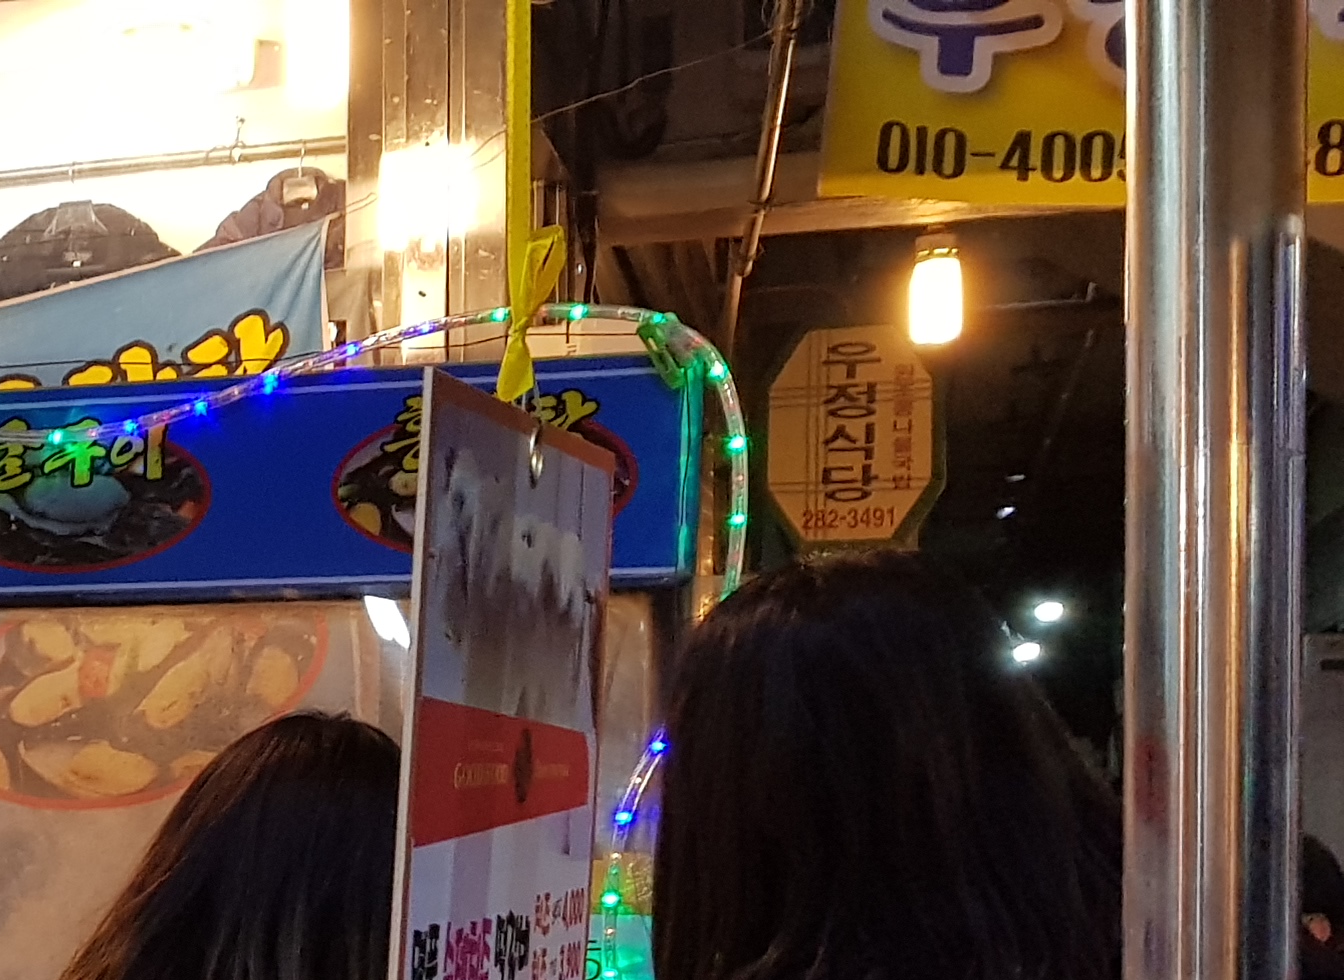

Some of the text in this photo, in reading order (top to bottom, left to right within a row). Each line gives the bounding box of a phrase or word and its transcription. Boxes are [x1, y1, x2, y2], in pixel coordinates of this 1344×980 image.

[876, 119, 1126, 183] 010-400
[822, 341, 882, 503] 우정식당
[801, 505, 896, 530] 282-3491
